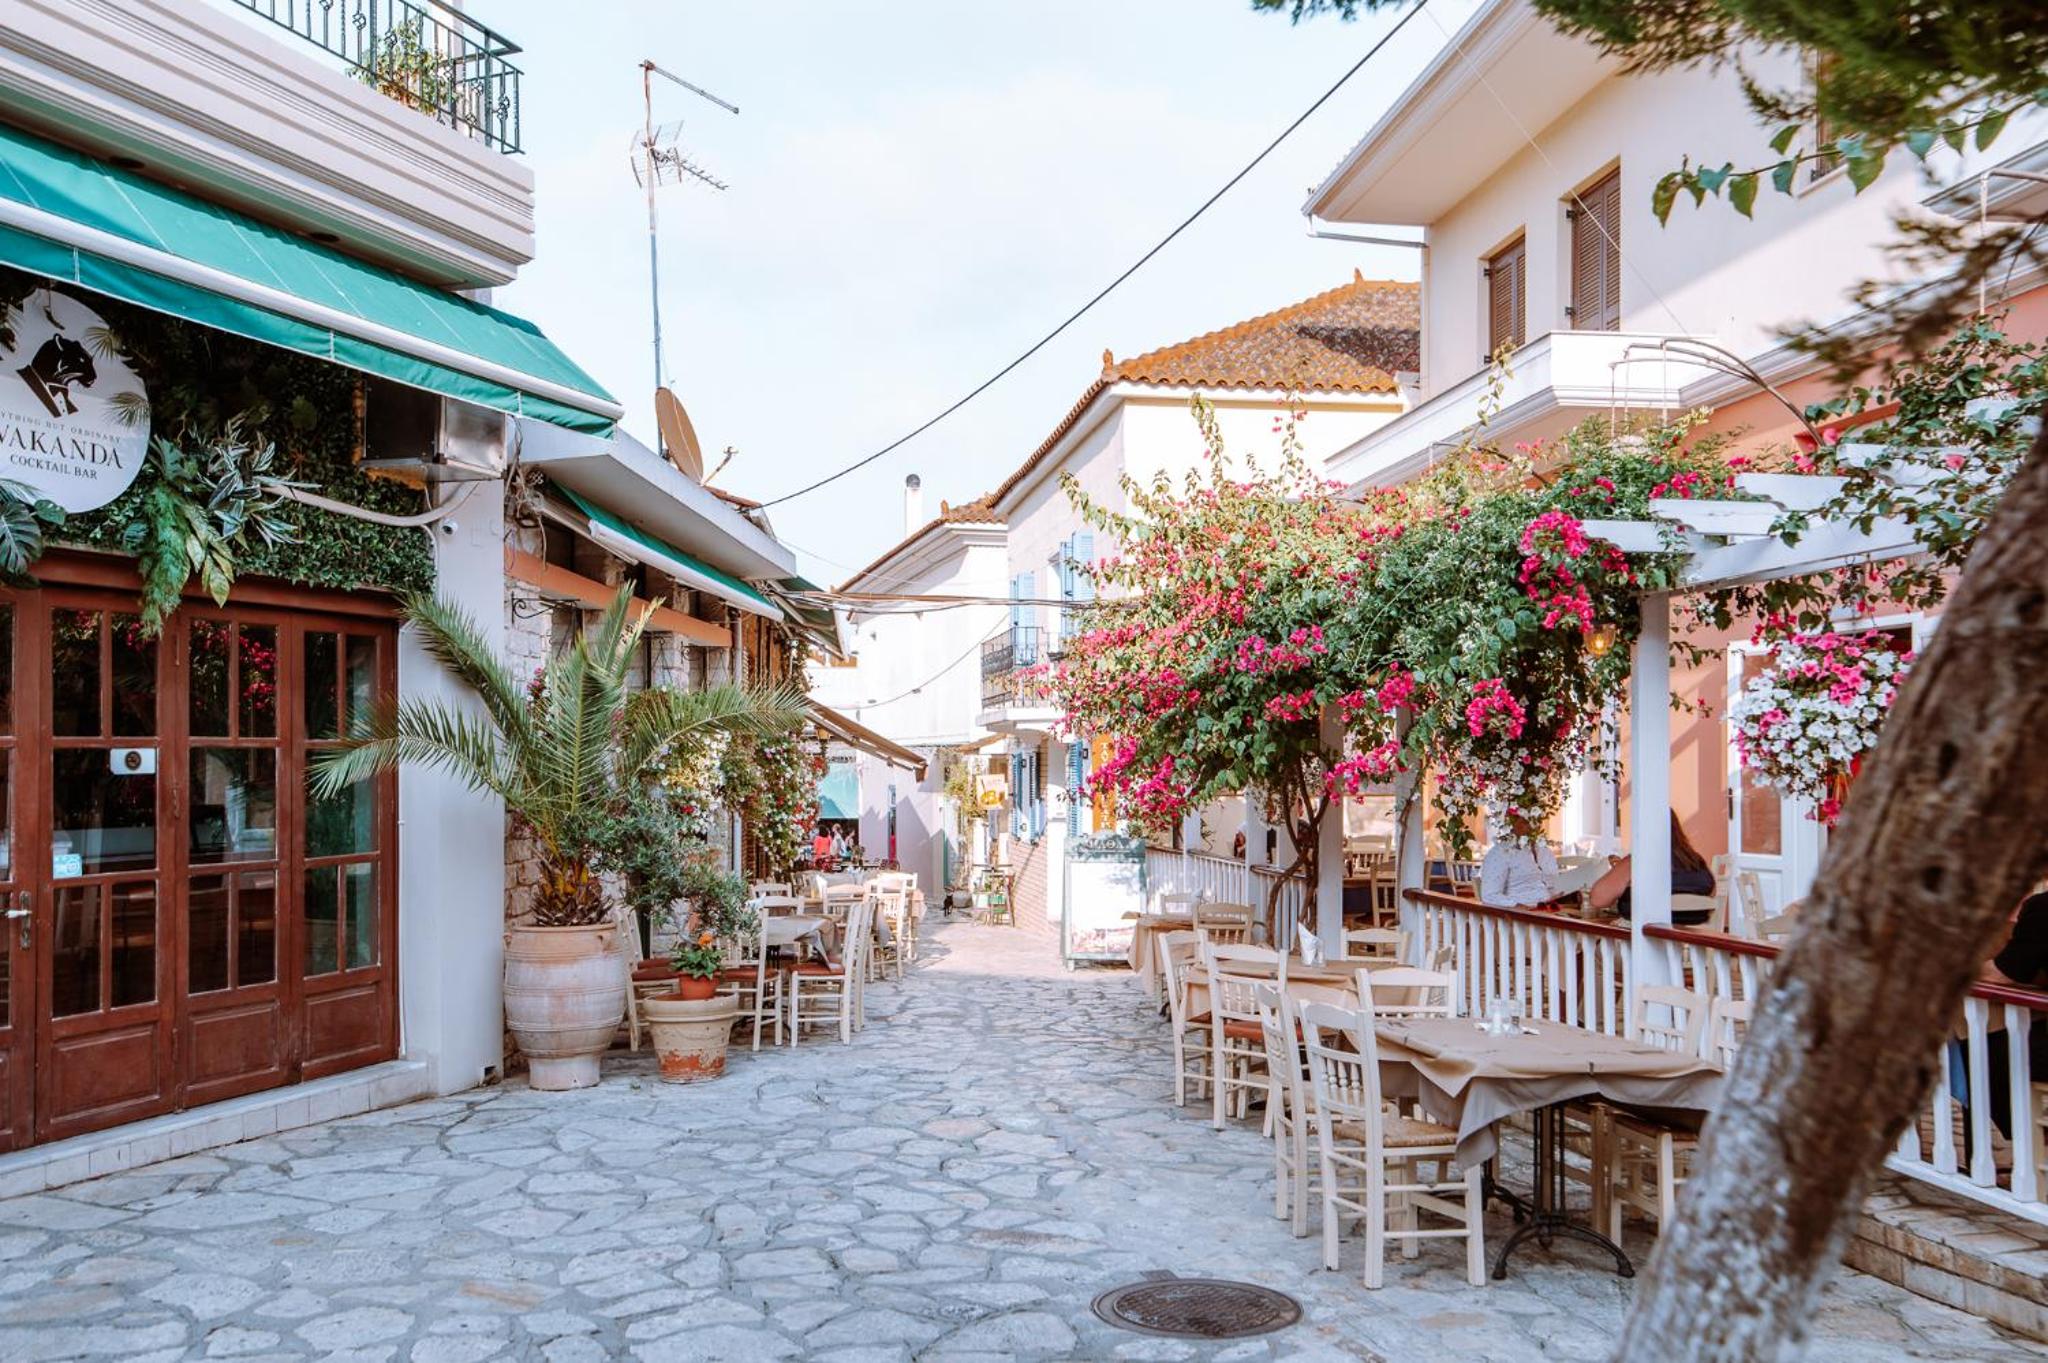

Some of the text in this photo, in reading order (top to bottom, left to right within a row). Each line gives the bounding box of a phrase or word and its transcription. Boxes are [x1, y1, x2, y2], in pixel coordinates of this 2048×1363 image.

[46, 420, 65, 431] BUT
[70, 426, 121, 444] ORDINARY
[10, 454, 98, 480] COCKTAIL BAR
